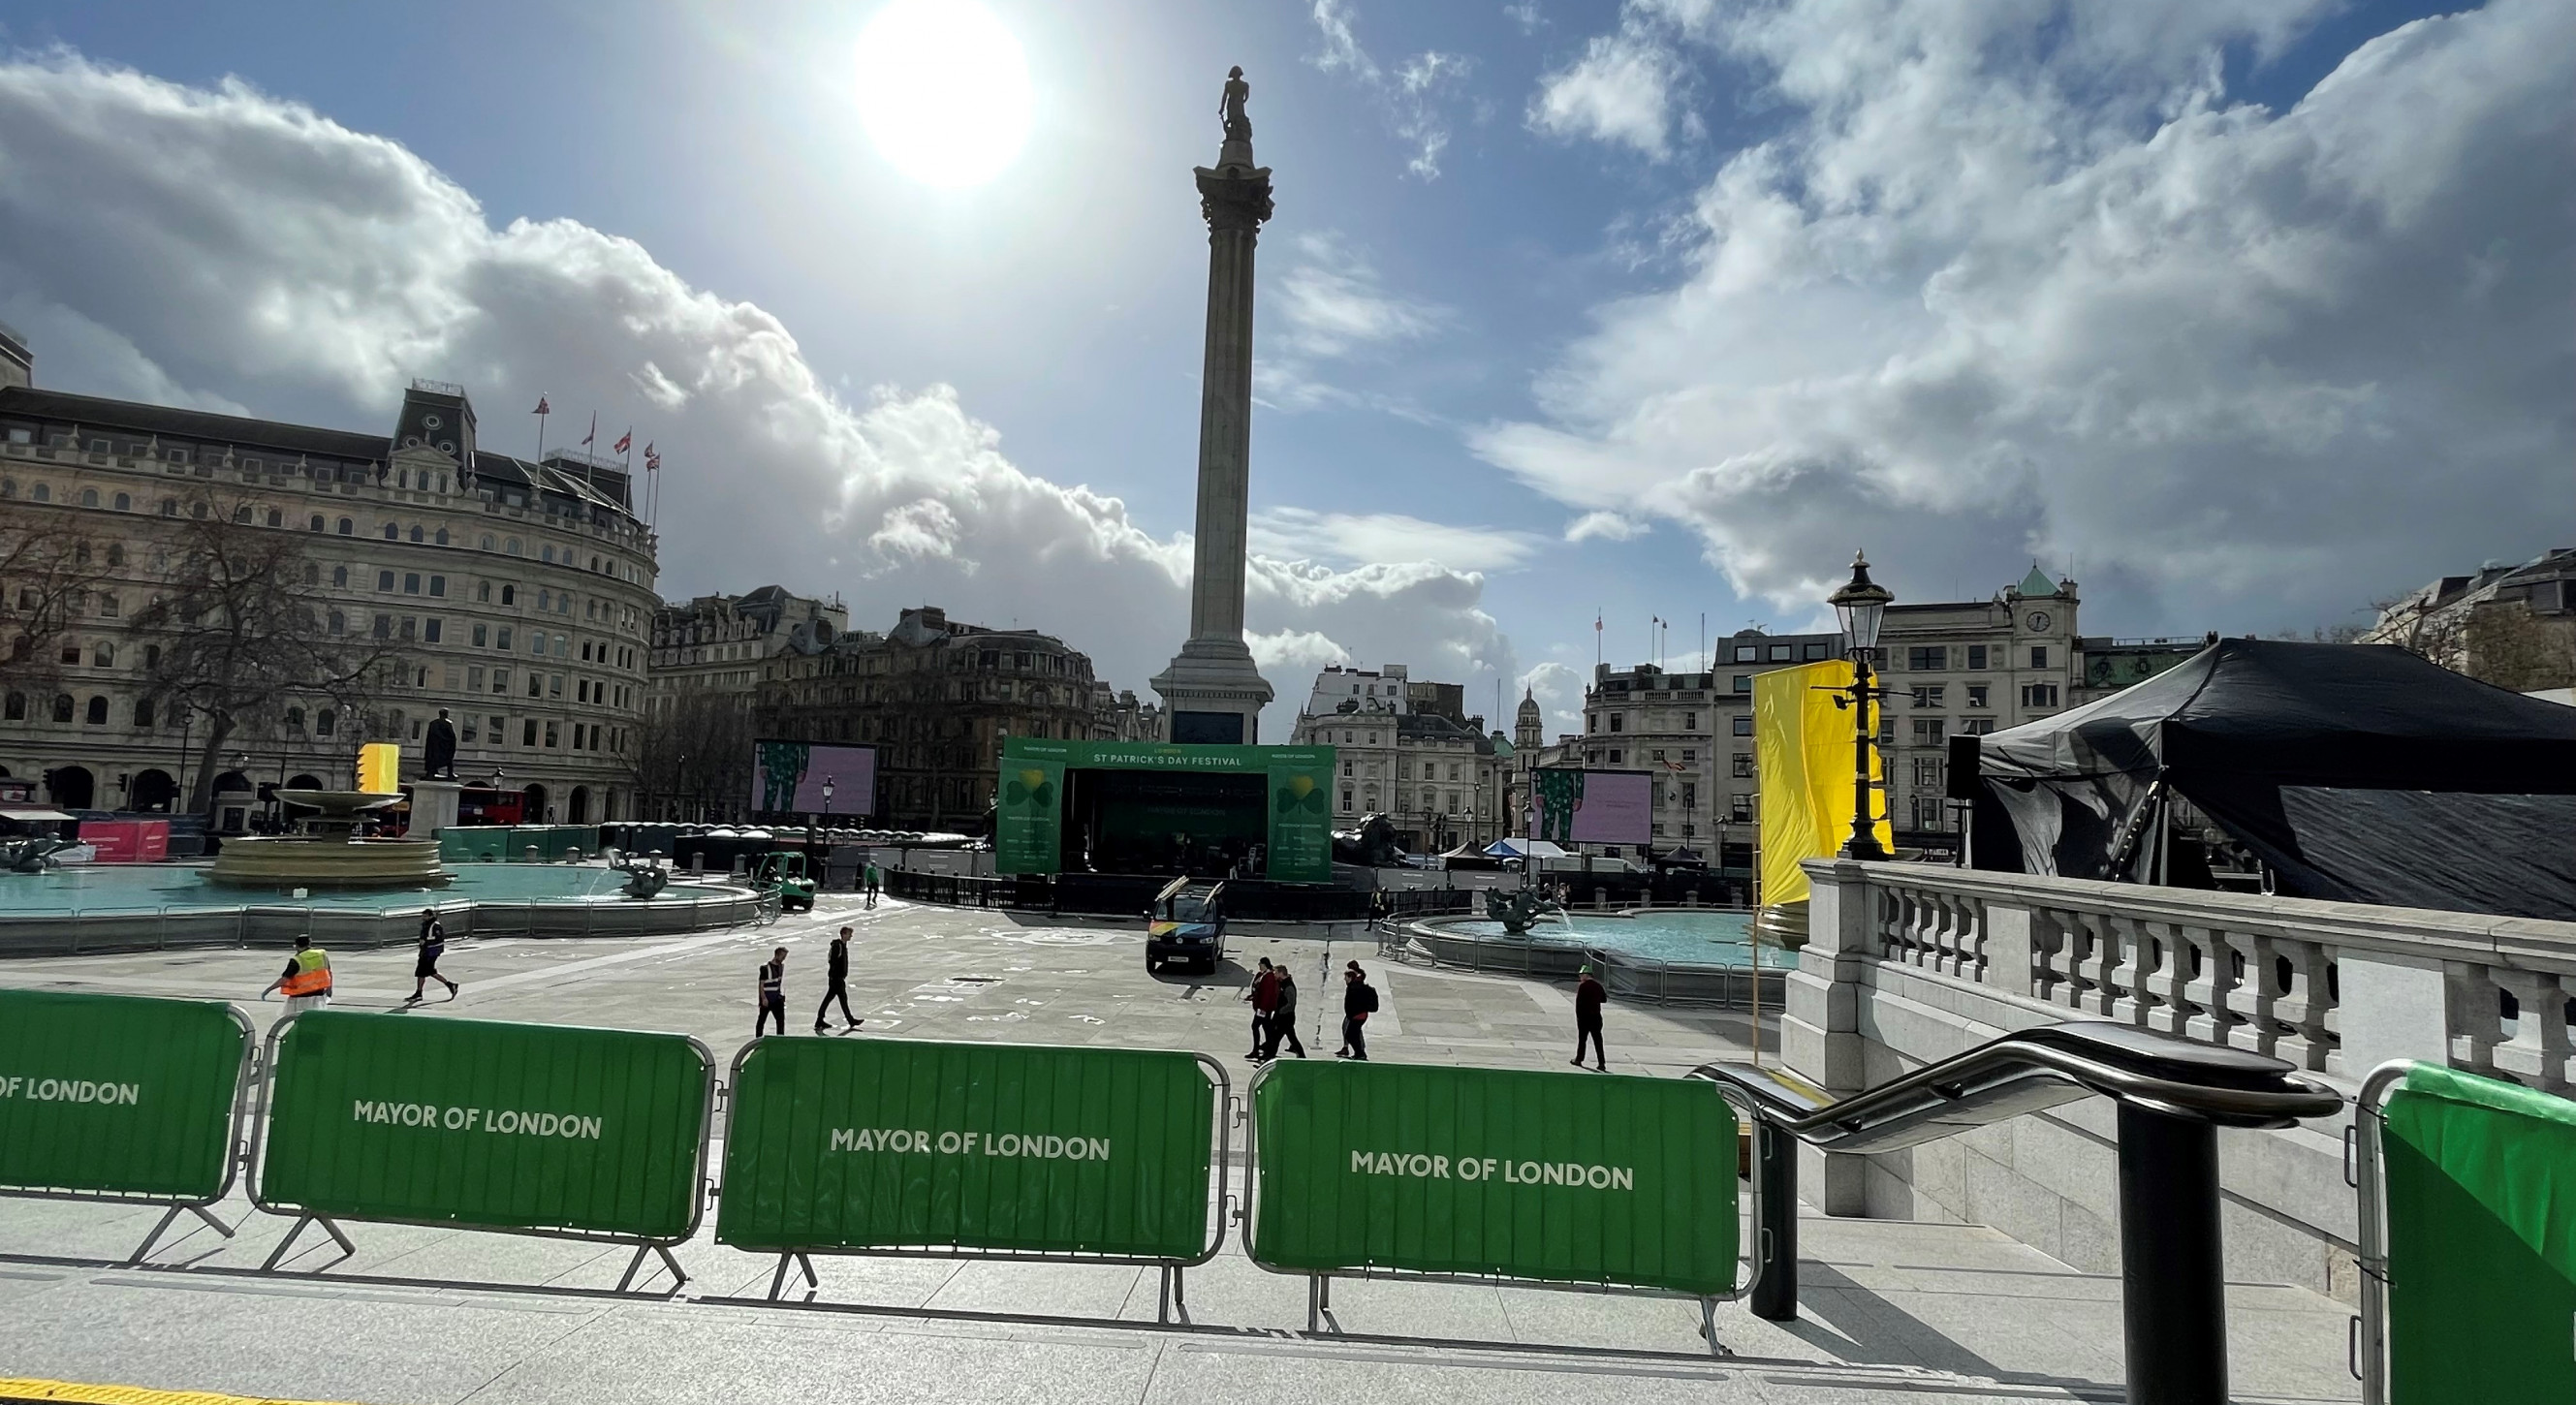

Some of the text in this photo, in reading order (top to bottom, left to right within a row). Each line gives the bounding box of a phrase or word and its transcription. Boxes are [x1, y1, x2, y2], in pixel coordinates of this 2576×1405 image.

[1093, 753, 1241, 766] ST PATRICK'S DAY FESTIVAL
[26, 1078, 140, 1105] LONDON
[354, 1100, 602, 1140] MAYOR OF LONDON
[831, 1128, 1110, 1161] MAYOR OF LONDON
[1351, 1150, 1633, 1191] MAYOR OF LONDON
